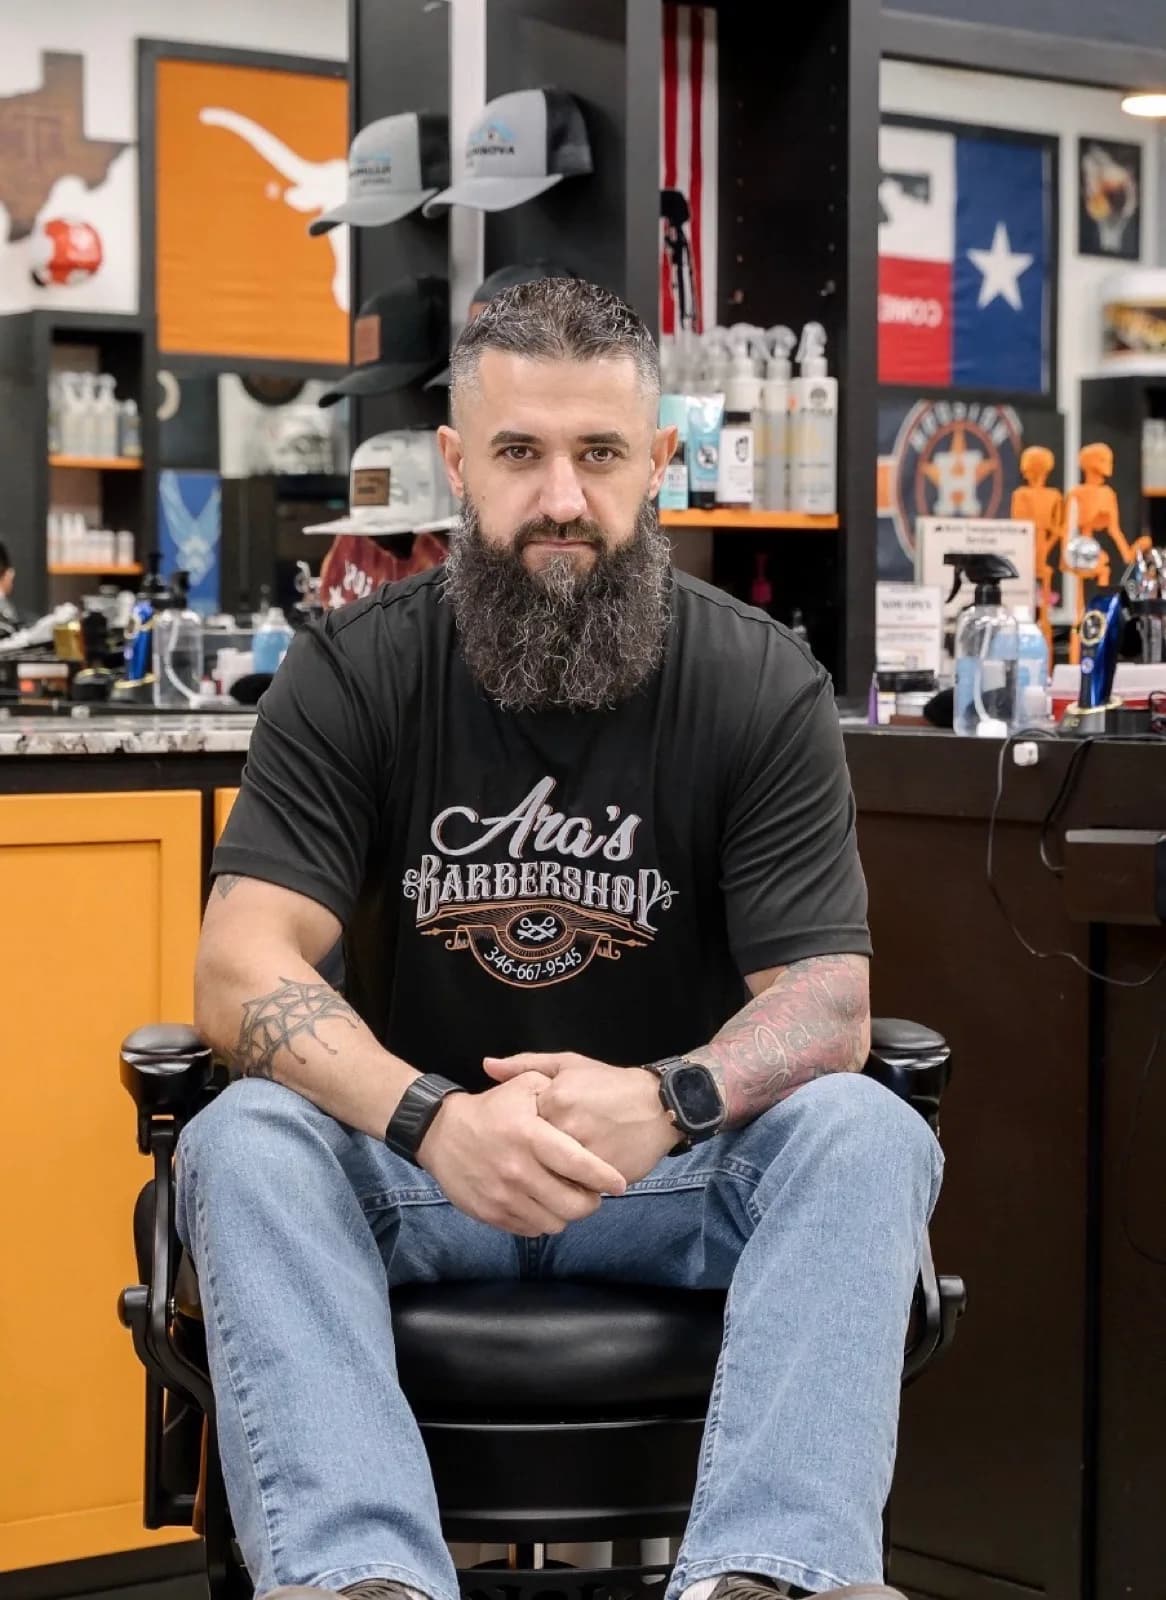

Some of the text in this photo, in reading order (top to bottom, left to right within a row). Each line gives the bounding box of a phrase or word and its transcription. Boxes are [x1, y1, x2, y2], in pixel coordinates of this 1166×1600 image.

[430, 775, 642, 862] Ara's
[403, 854, 672, 934] BARBERSHOP
[483, 945, 583, 981] 346-667-9545
